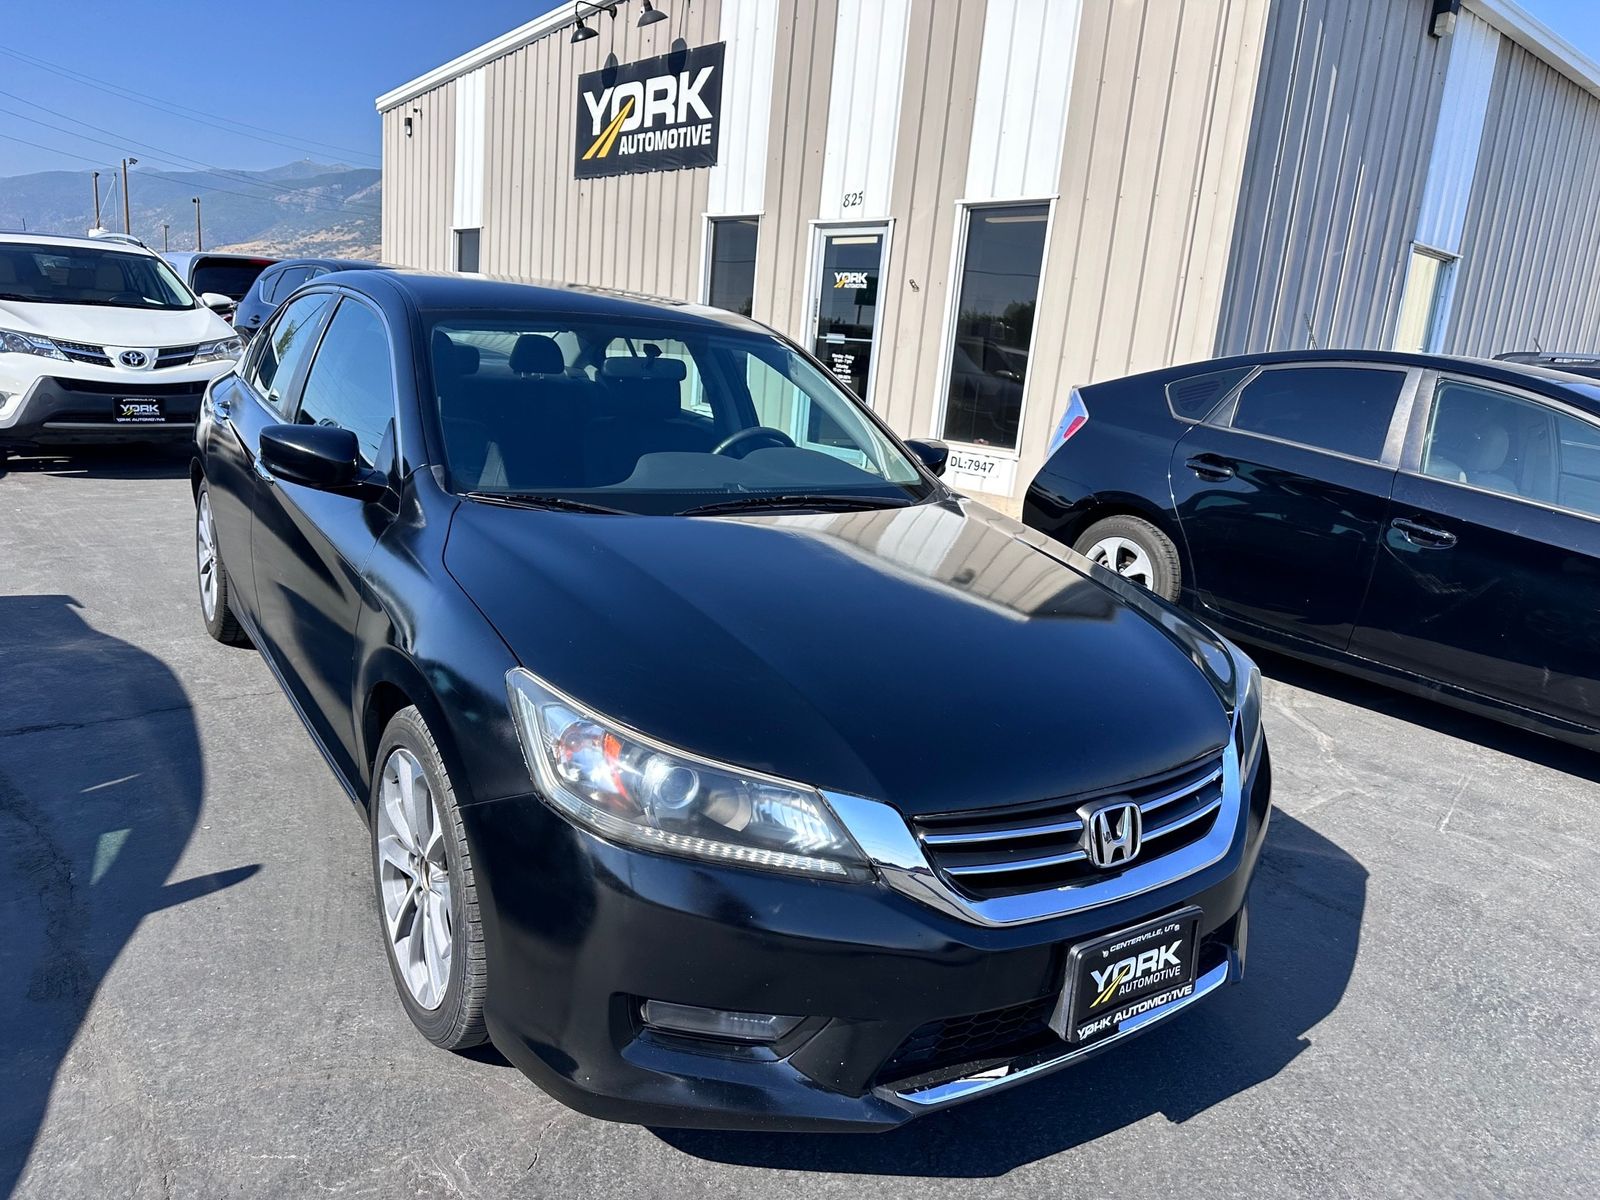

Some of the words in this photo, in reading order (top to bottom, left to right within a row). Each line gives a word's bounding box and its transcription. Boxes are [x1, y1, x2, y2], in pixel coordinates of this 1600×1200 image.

[583, 66, 715, 136] YORK
[618, 123, 712, 156] AUTOMOTIVE
[843, 191, 863, 208] 825
[834, 271, 868, 284] YORK
[120, 404, 159, 412] YORK
[950, 456, 995, 474] DL:7947
[1109, 928, 1164, 952] CENTERVILLE,
[1164, 923, 1175, 933] UT
[1090, 939, 1183, 994] YORK
[1118, 965, 1181, 996] AUTOMOTIVE
[1113, 985, 1193, 1024] AUTOMOTIVE
